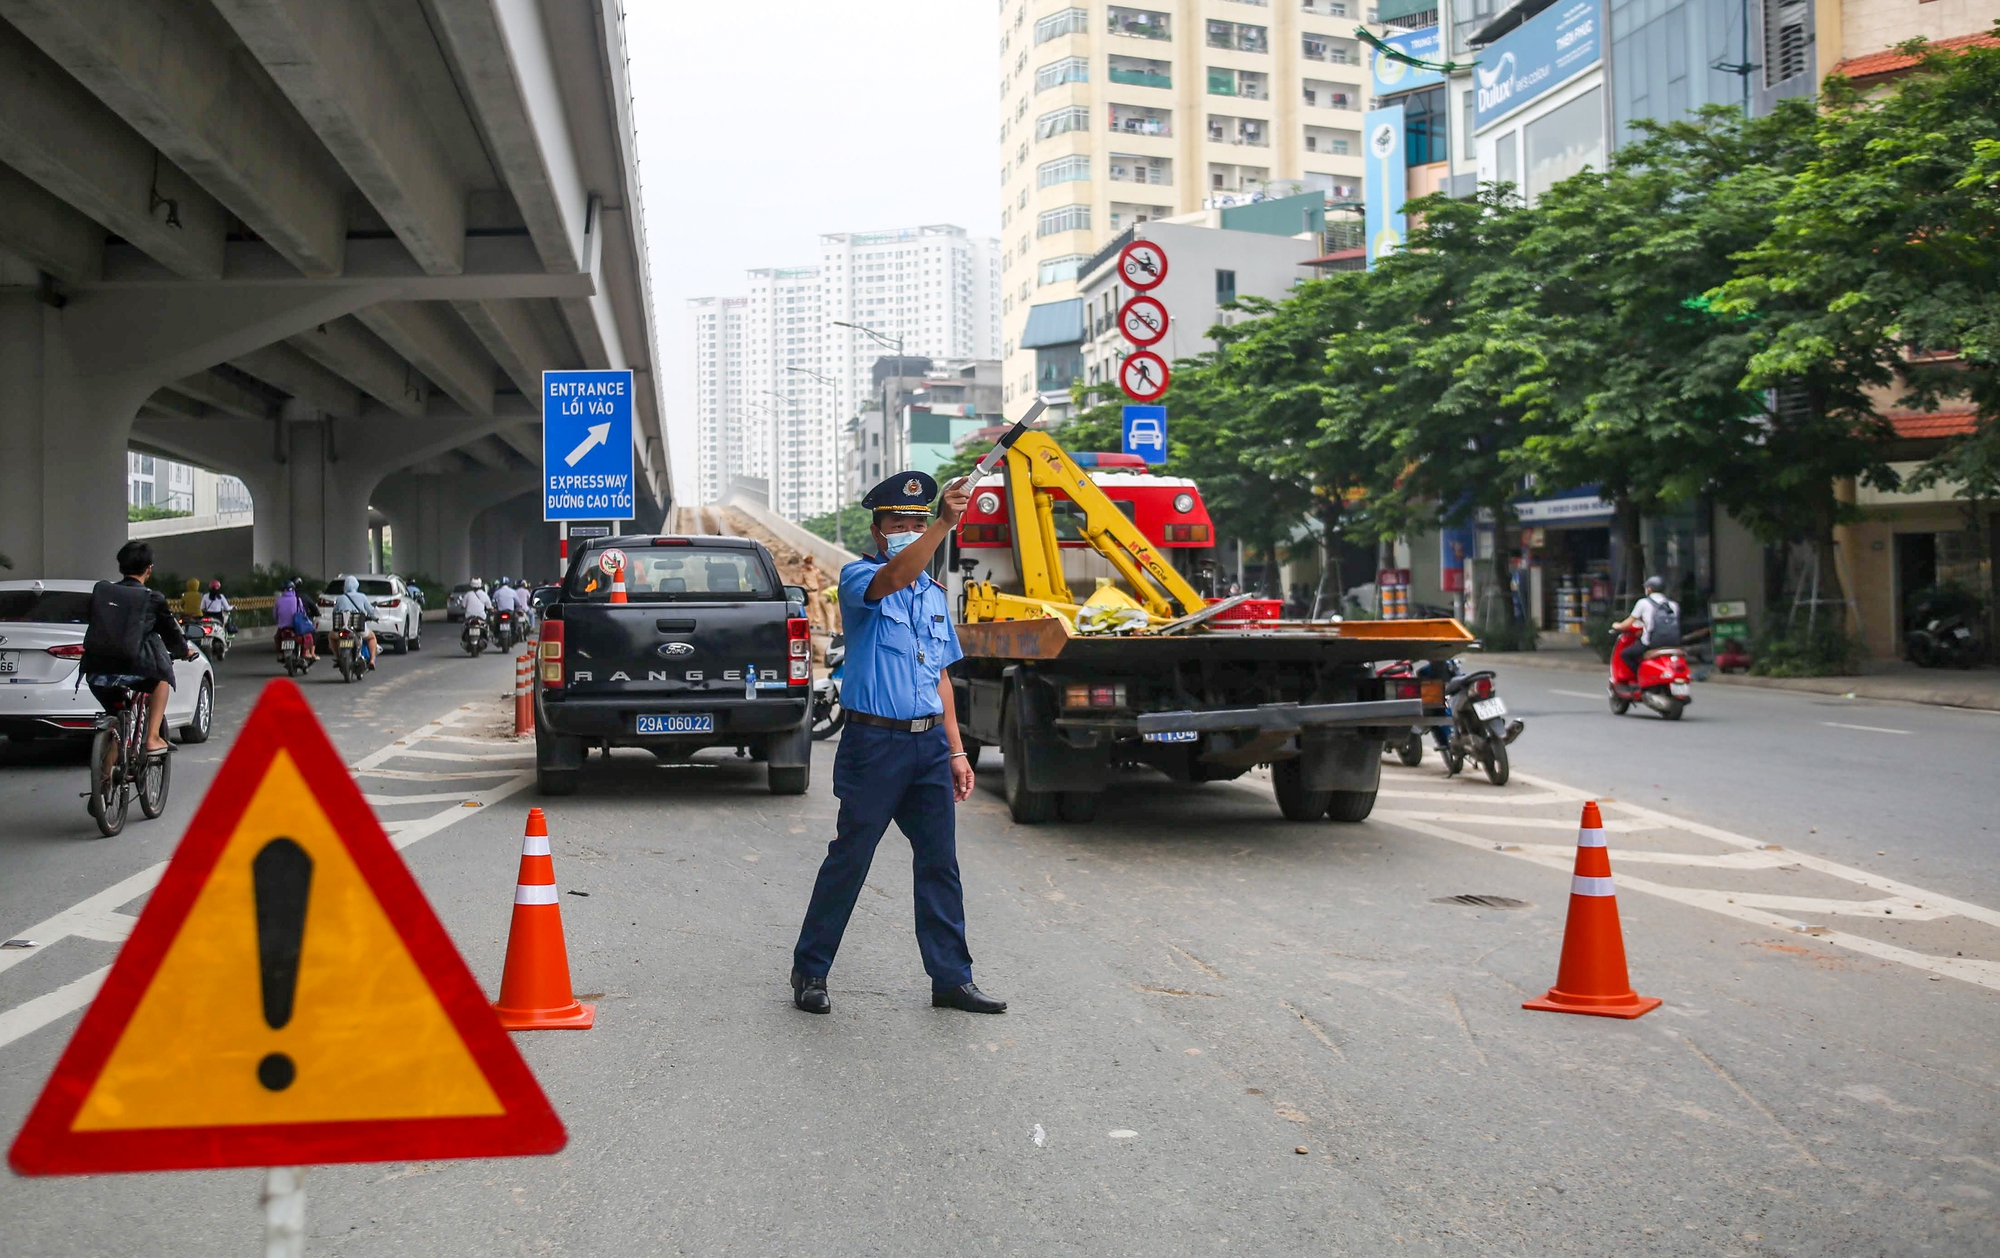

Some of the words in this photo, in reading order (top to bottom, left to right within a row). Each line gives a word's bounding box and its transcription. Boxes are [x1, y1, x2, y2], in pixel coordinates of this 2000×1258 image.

[1478, 80, 1513, 113] Dulux
[550, 382, 624, 396] ENTRANCE
[562, 397, 583, 415] LỐI
[588, 398, 614, 415] VÀO
[550, 474, 628, 489] EXPRESSWAY
[548, 490, 584, 509] ĐƯỜNG
[586, 495, 608, 508] CAO
[610, 489, 631, 508] TỐC
[665, 644, 687, 655] Ford
[574, 670, 778, 681] RANGER
[638, 717, 711, 732] 29A-060.22
